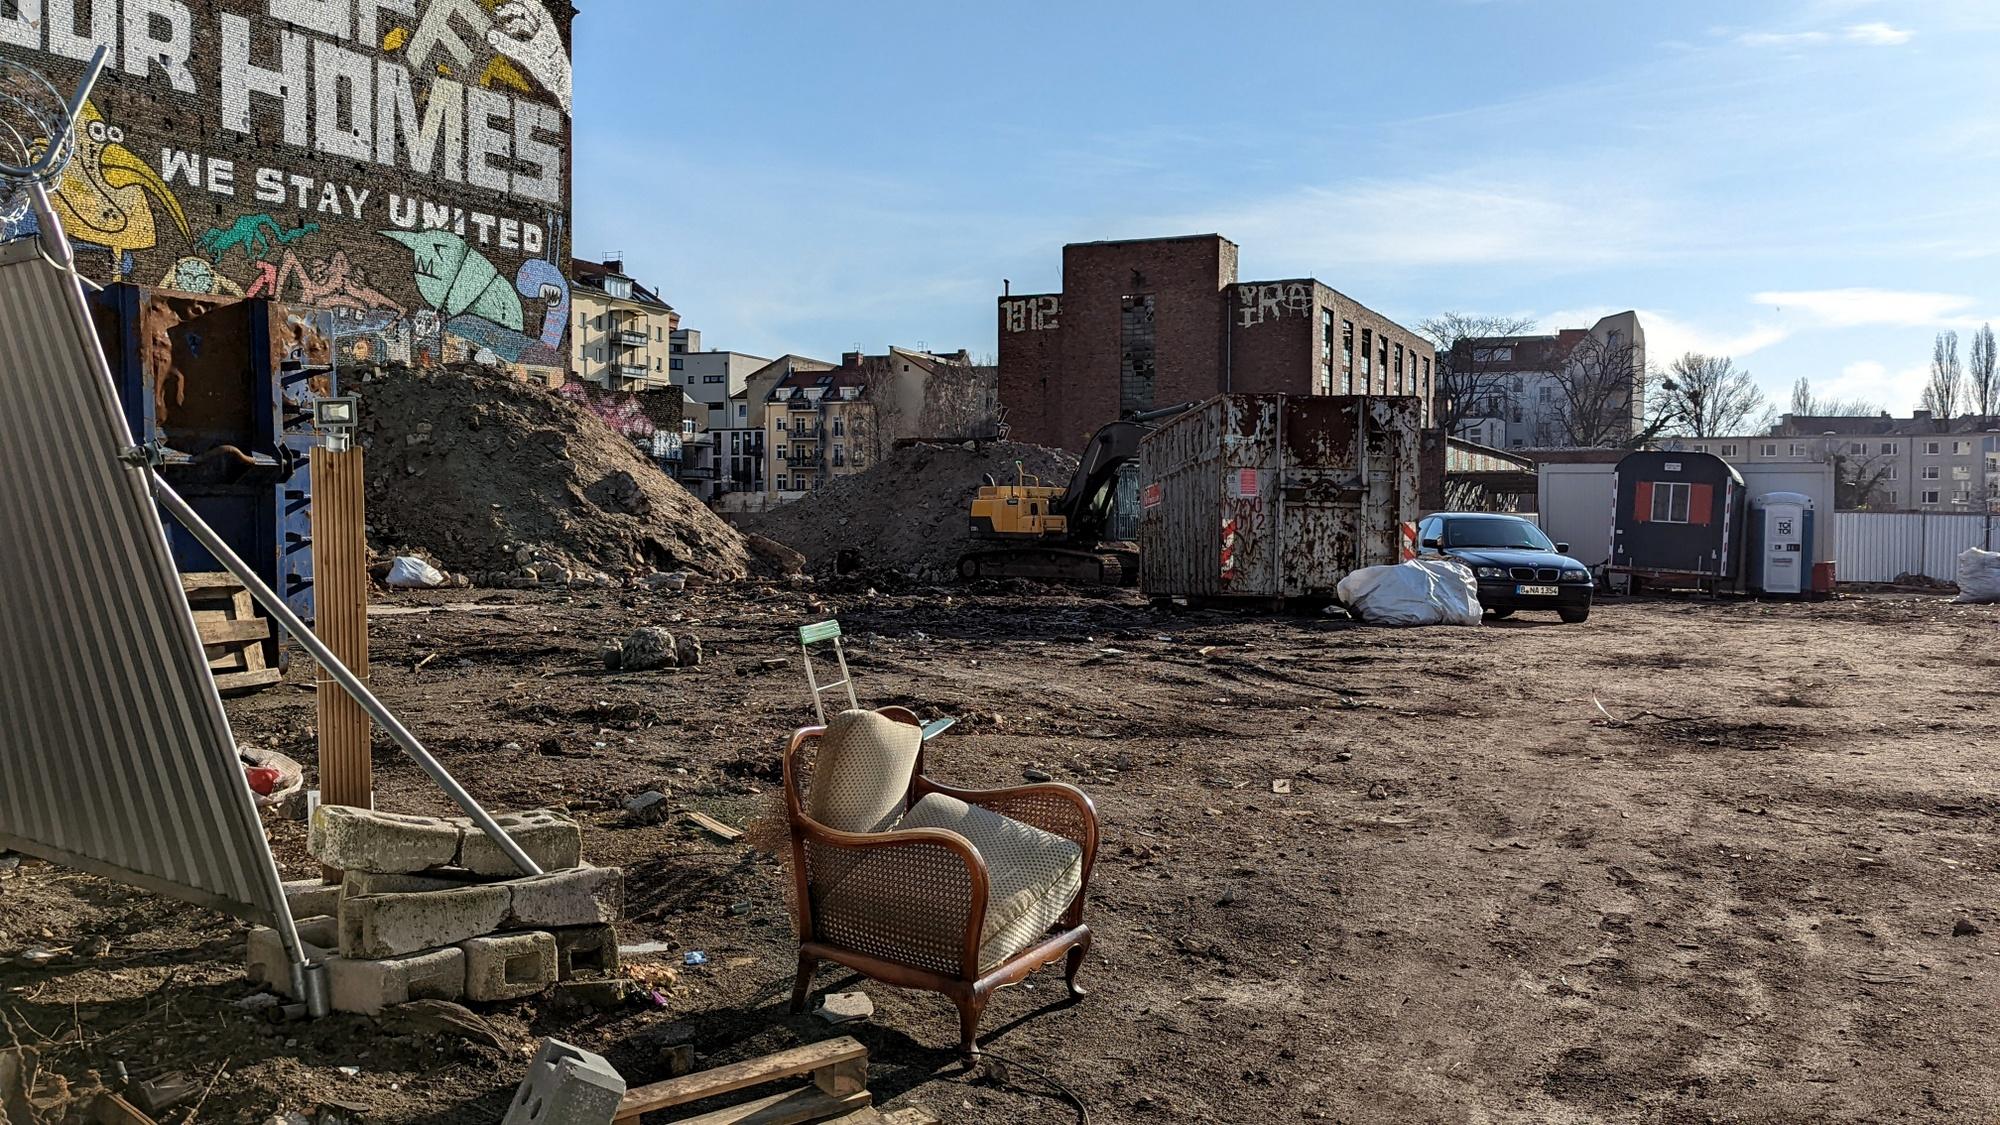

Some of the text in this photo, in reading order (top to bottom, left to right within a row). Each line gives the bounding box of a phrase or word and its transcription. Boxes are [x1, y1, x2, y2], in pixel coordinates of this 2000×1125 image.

[0, 0, 197, 94] UR
[220, 12, 561, 202] HOMES
[162, 147, 543, 253] WE STAY UNITED
[1000, 296, 1060, 332] 1312
